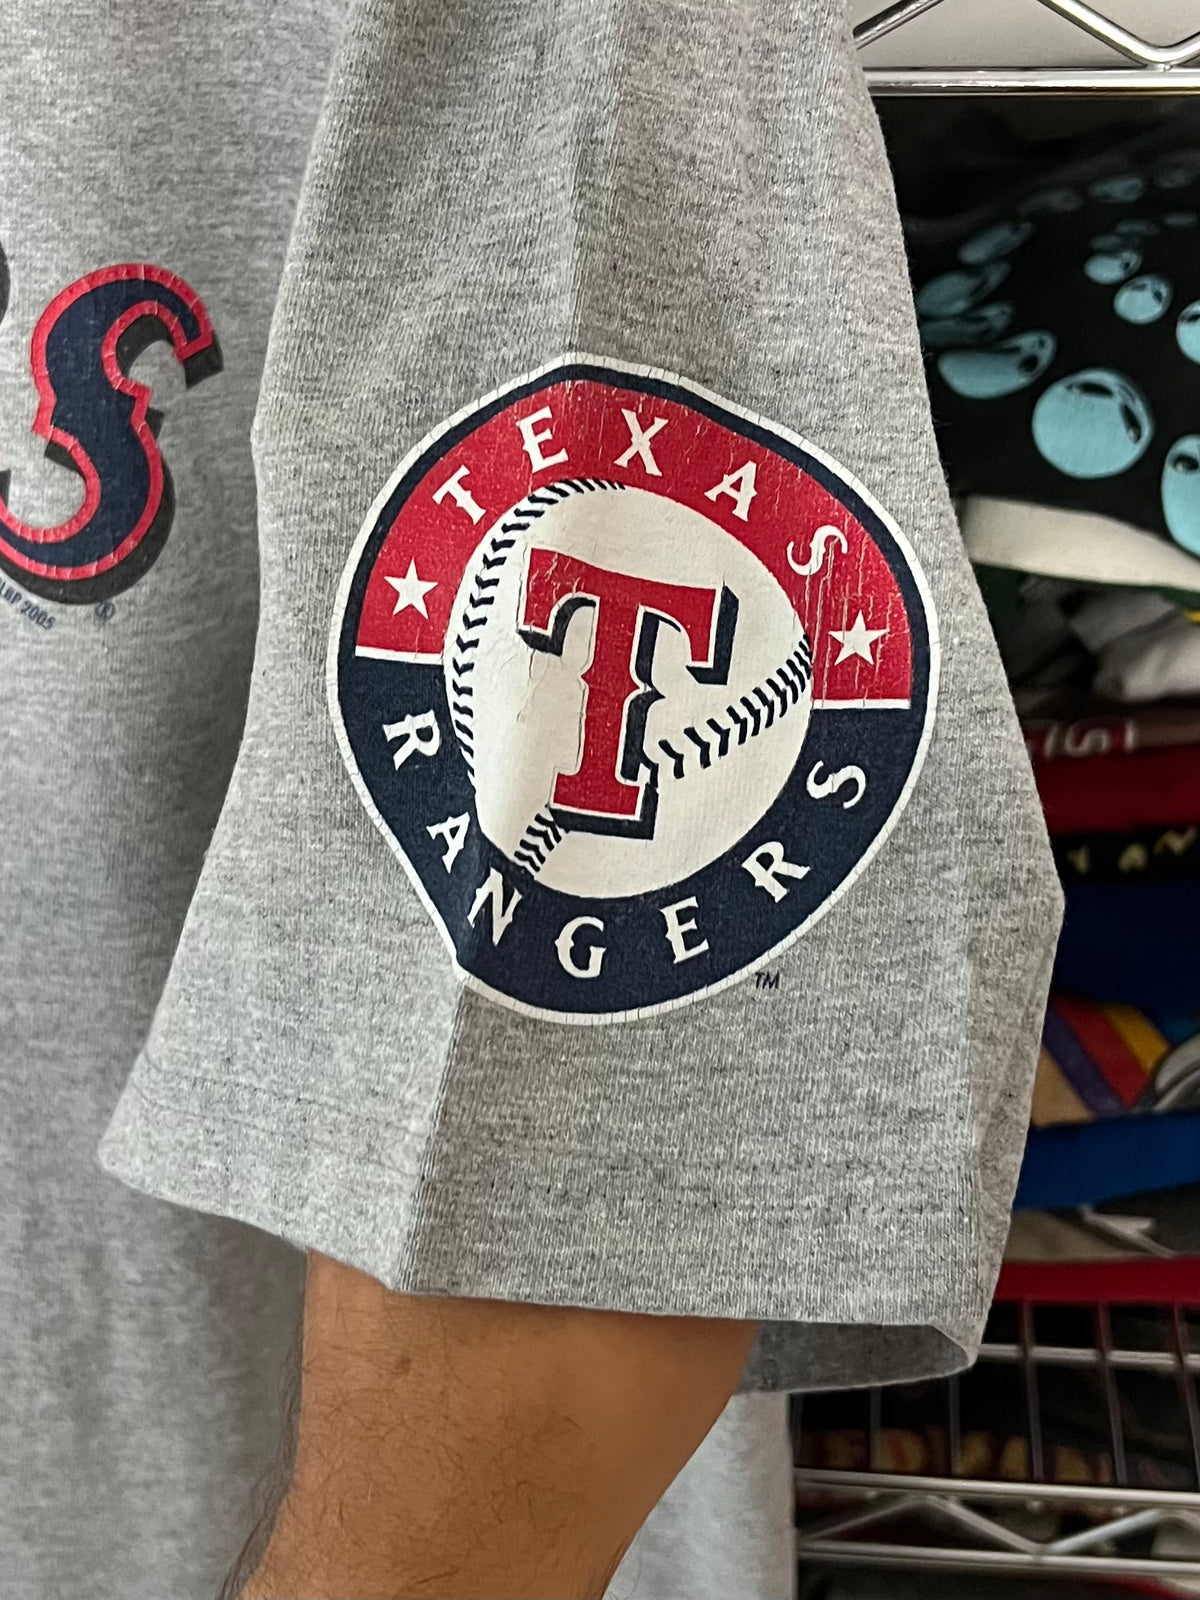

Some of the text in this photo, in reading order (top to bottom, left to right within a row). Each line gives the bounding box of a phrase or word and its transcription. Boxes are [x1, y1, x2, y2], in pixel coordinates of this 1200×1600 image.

[433, 407, 849, 576] TEXAS
[516, 546, 739, 840] T
[382, 709, 868, 978] RANGERS
